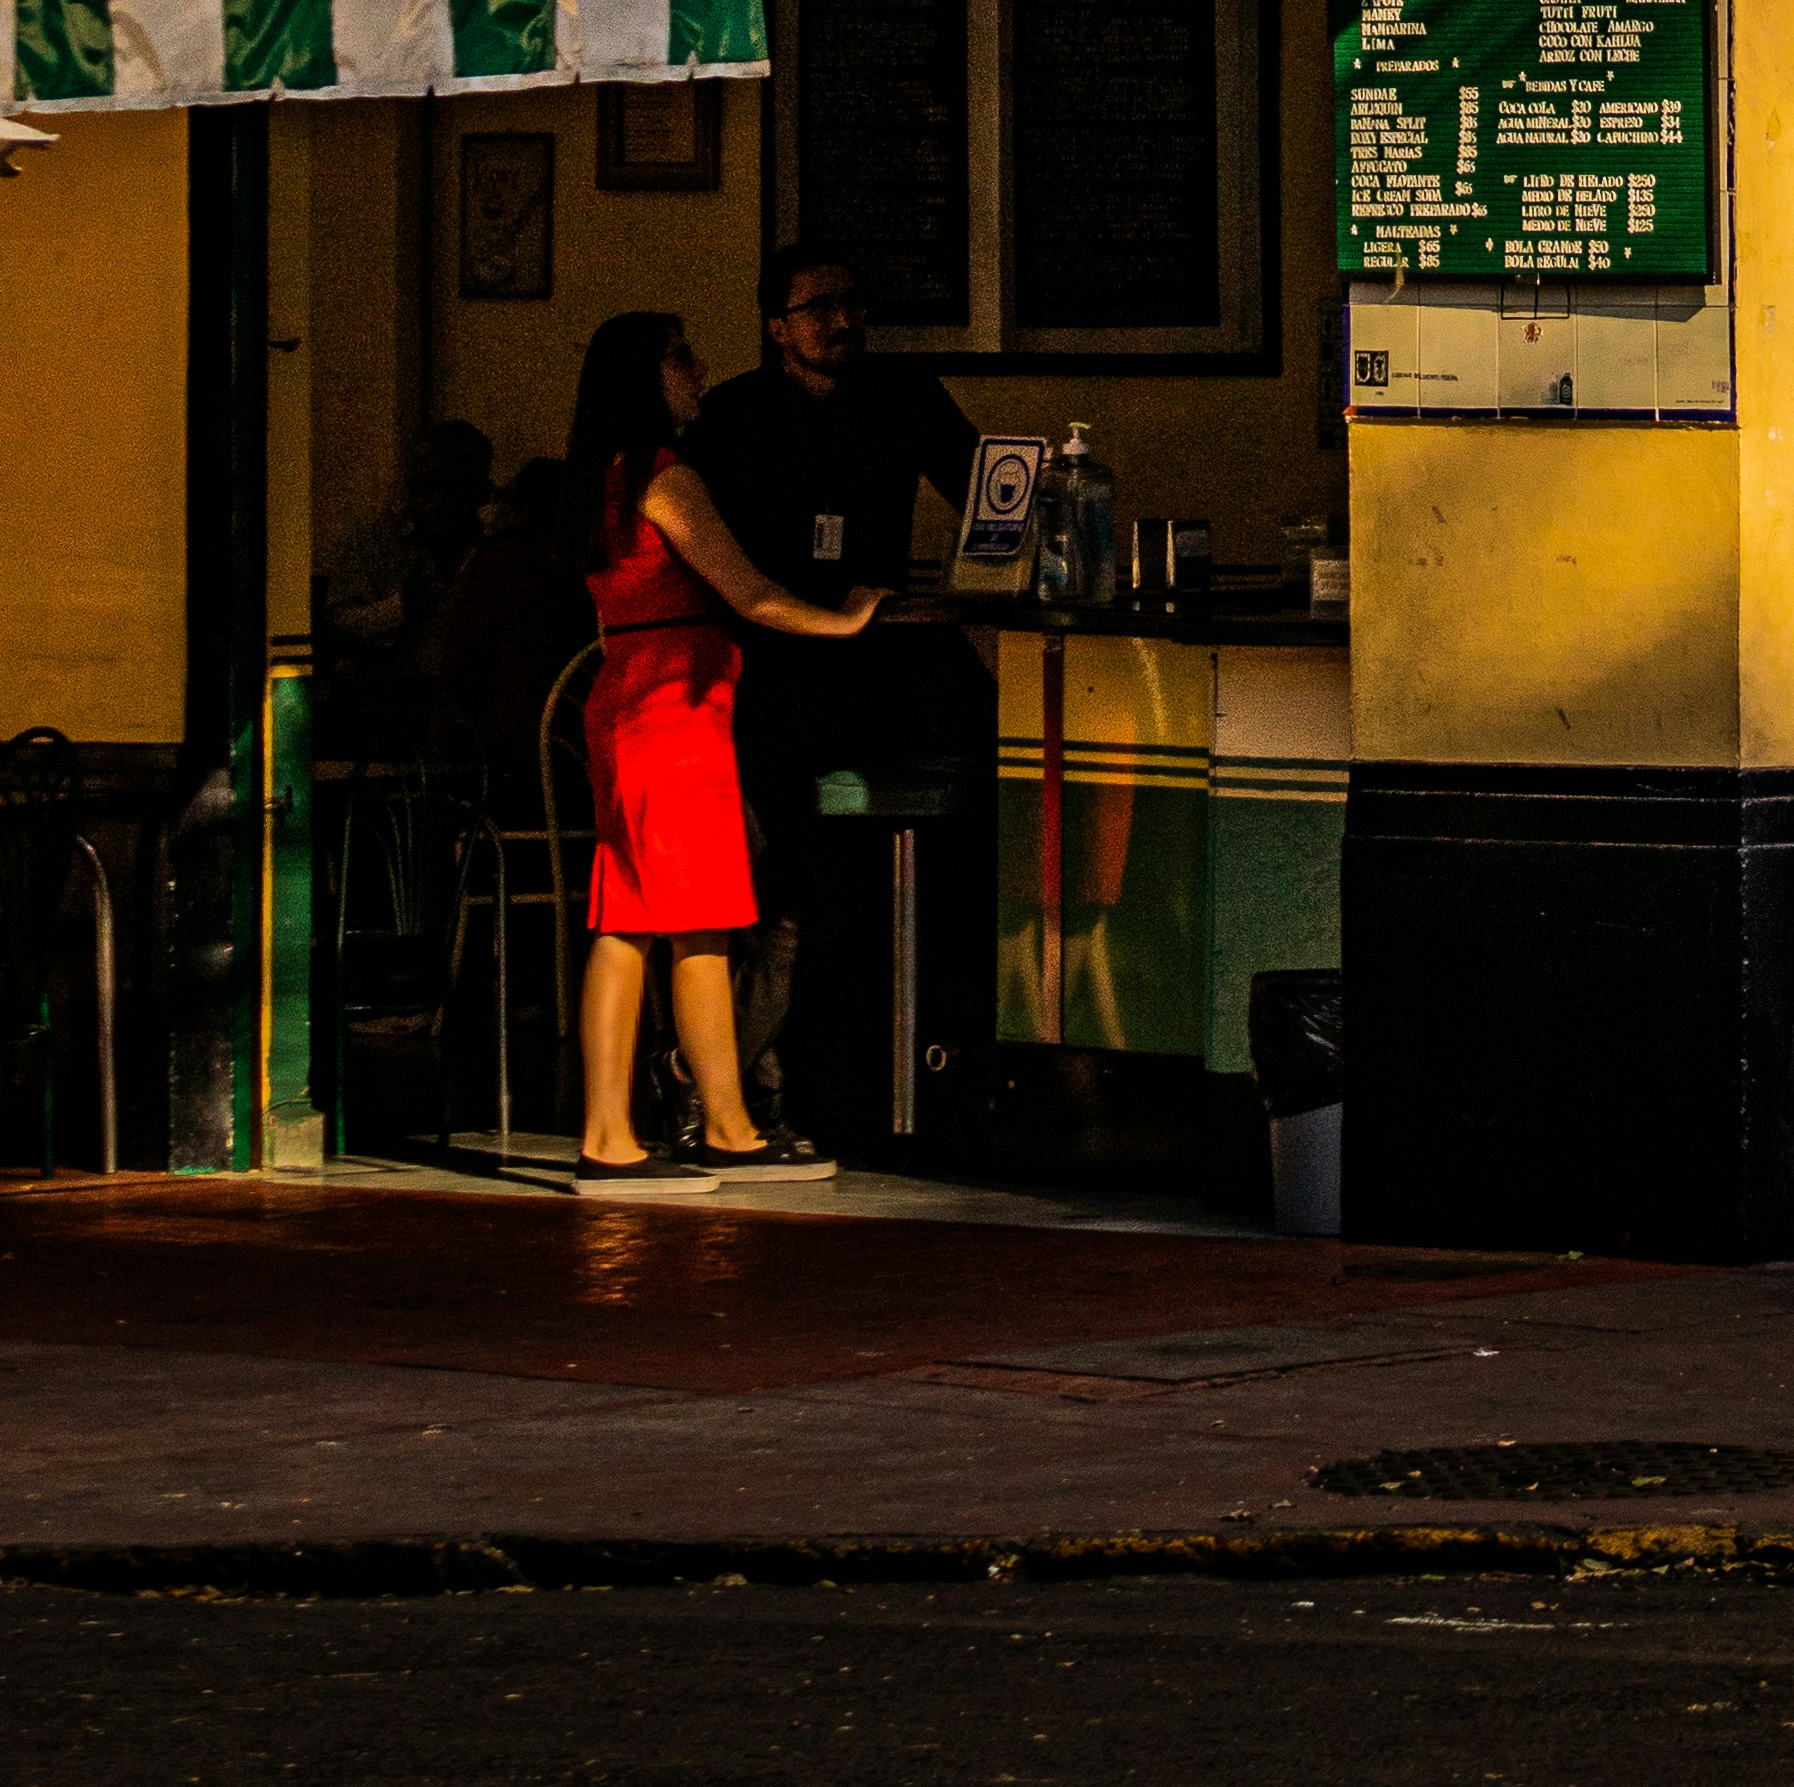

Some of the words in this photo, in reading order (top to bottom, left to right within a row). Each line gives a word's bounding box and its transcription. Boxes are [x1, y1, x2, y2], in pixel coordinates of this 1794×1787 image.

[1581, 5, 1618, 20] FRUTI
[1538, 20, 1599, 35] CHOCOLATE
[1607, 18, 1655, 34] AMARGO
[1361, 38, 1396, 52] LIMA
[1538, 34, 1568, 48] COCO
[1570, 34, 1593, 48] CON
[1538, 49, 1576, 63] ARROZ
[1579, 49, 1602, 63] CON
[1606, 49, 1641, 63] LECHE
[1375, 59, 1441, 73] PREPARADOS
[1350, 87, 1398, 102] SUNDAE
[1458, 85, 1480, 101] $55
[1525, 80, 1568, 94] BEBIDAS
[1568, 78, 1578, 92] Y
[1498, 100, 1527, 116] COCA
[1527, 100, 1556, 115] COLA
[1599, 101, 1660, 115] AMERICANO
[1660, 98, 1682, 115] $39
[1599, 116, 1644, 130] ESPRESO
[1496, 131, 1525, 145] AGUA
[1660, 128, 1683, 145] $44
[1350, 173, 1381, 188] COCA
[1386, 173, 1441, 189] FLOTANTE
[1559, 173, 1575, 188] DE
[1578, 173, 1624, 188] HELADO
[1627, 172, 1657, 189] $250
[1351, 188, 1372, 203] ICE
[1376, 189, 1412, 203] CREAM
[1415, 188, 1443, 203] SODA
[1521, 204, 1553, 218] LITRO
[1555, 204, 1570, 218] DE
[1574, 203, 1607, 218] NIEVE
[1363, 241, 1403, 254] LIGERA
[1418, 239, 1440, 255] $65
[1504, 239, 1535, 254] BOLA
[1537, 239, 1583, 254] GRANDE
[1587, 239, 1610, 255] $50
